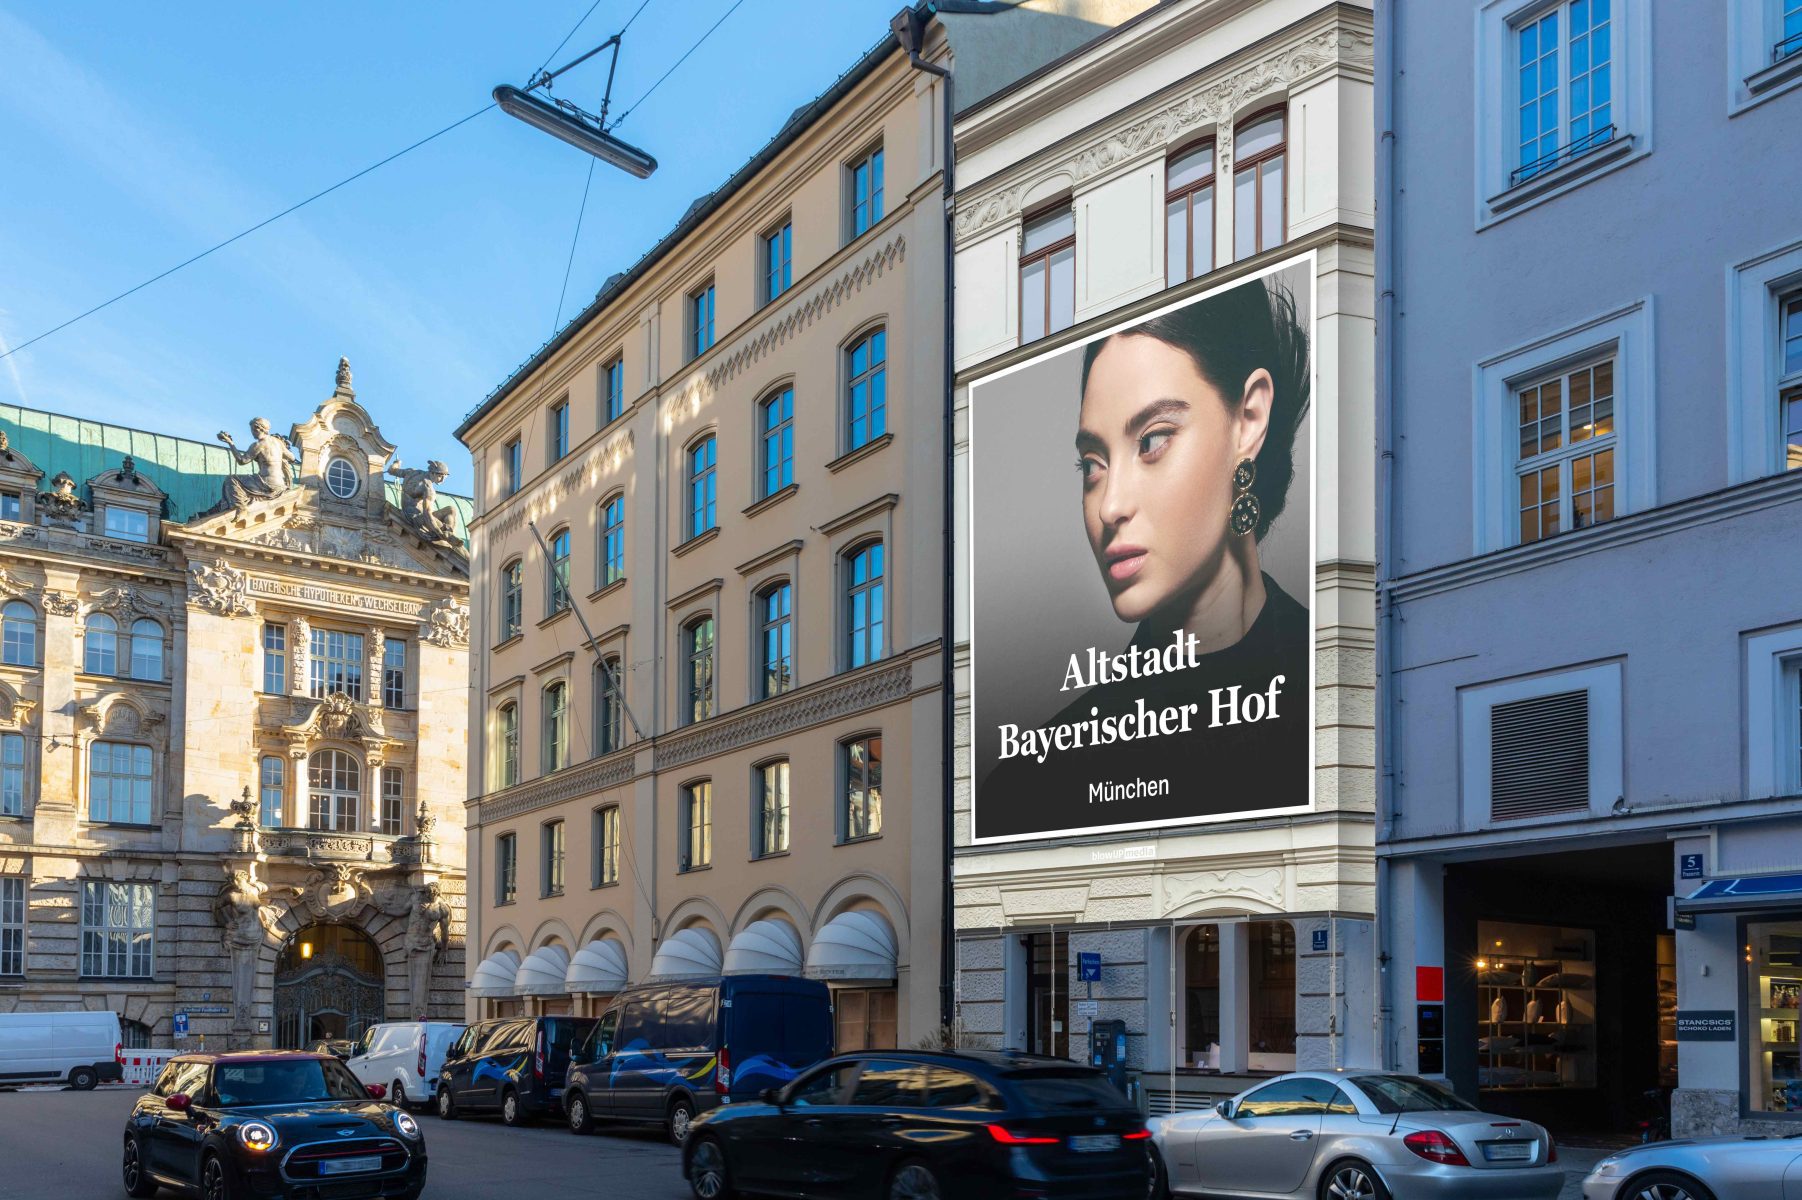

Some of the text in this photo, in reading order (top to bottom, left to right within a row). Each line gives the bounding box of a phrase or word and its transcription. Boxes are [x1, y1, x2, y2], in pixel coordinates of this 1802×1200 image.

[252, 579, 302, 597] BAYERISCHE
[1059, 628, 1200, 692] Altstadt
[998, 674, 1286, 764] Bayerischer Hof
[1089, 777, 1169, 803] München
[1687, 855, 1696, 868] 5
